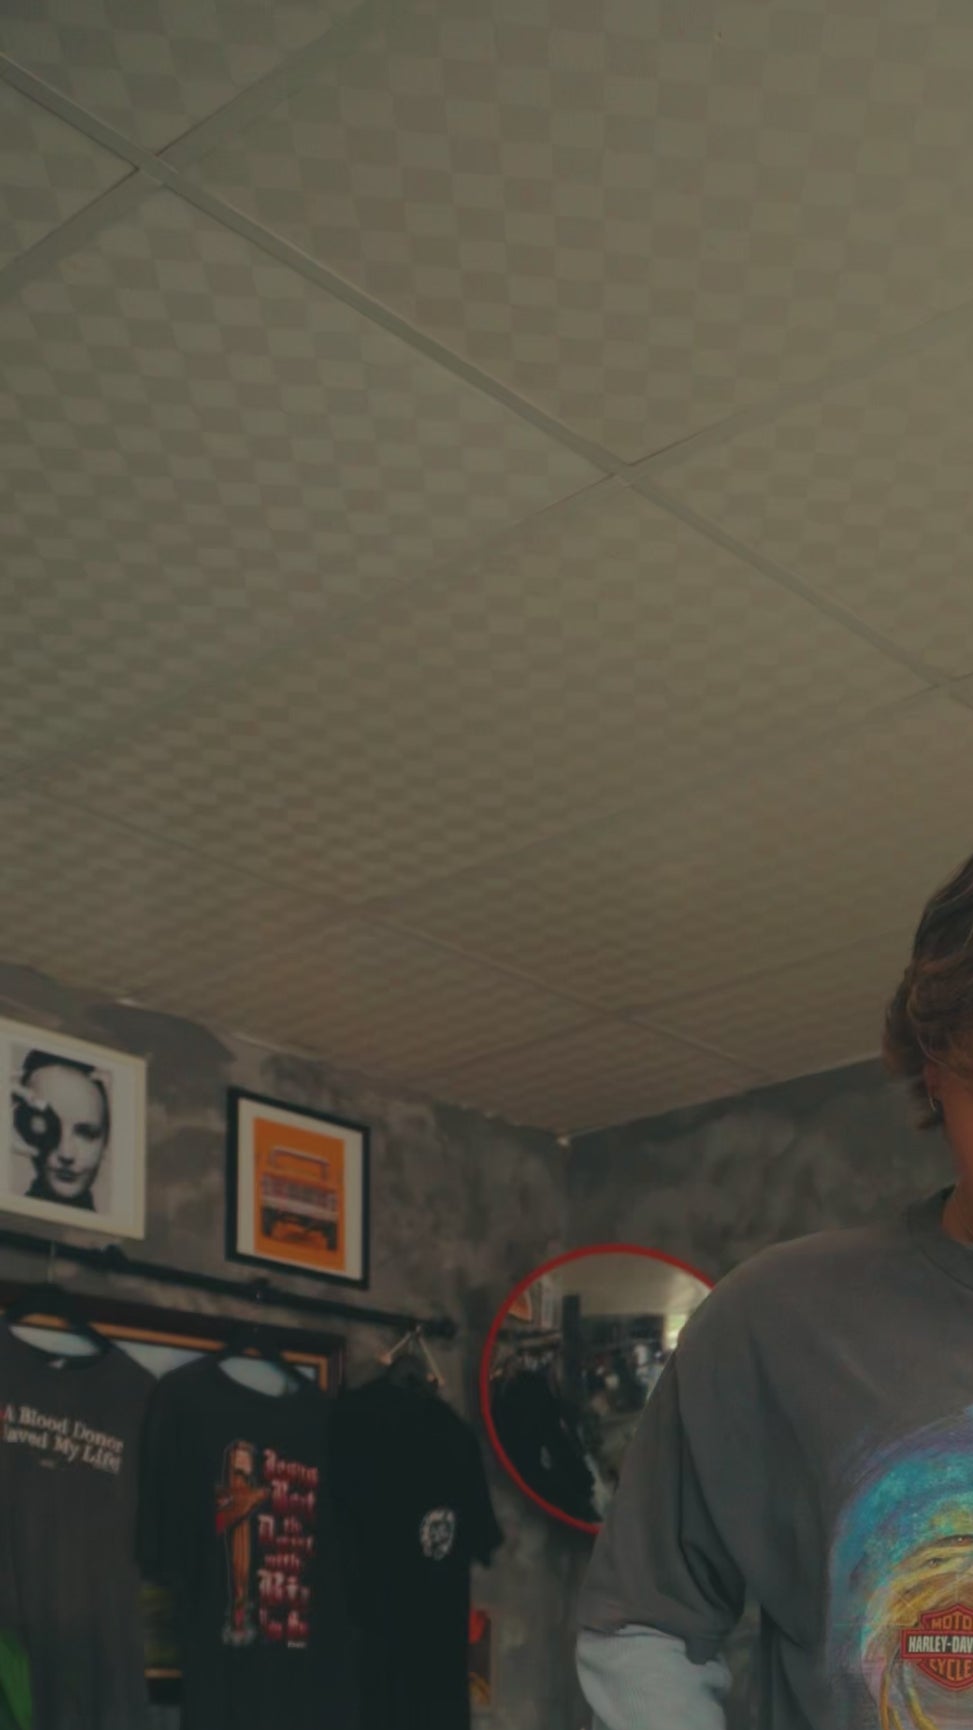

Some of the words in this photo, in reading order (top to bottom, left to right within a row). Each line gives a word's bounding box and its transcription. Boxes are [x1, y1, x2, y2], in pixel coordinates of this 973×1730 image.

[19, 1405, 67, 1434] Blood
[73, 1420, 124, 1453] Donor
[54, 1434, 80, 1463] My
